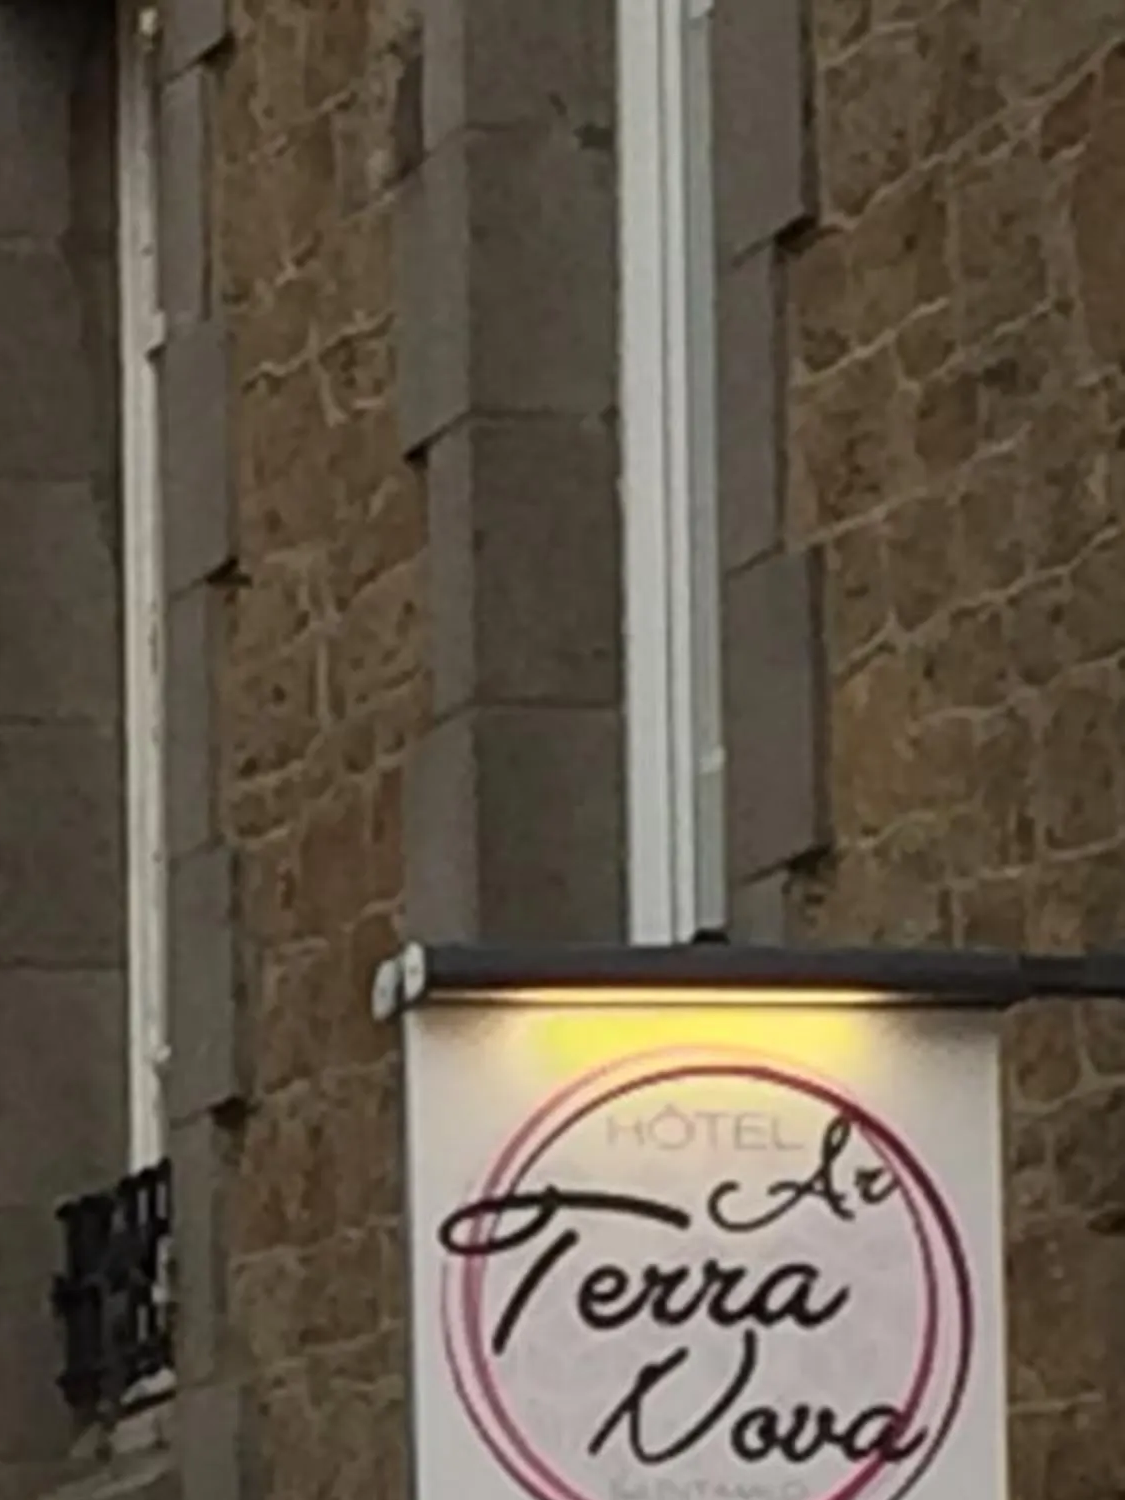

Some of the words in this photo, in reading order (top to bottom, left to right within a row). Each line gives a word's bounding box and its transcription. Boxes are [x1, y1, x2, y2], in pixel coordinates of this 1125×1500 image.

[606, 1102, 806, 1153] HÔTEL
[706, 1107, 901, 1231] Ar
[438, 1184, 850, 1357] Terra
[588, 1330, 928, 1465] Nova
